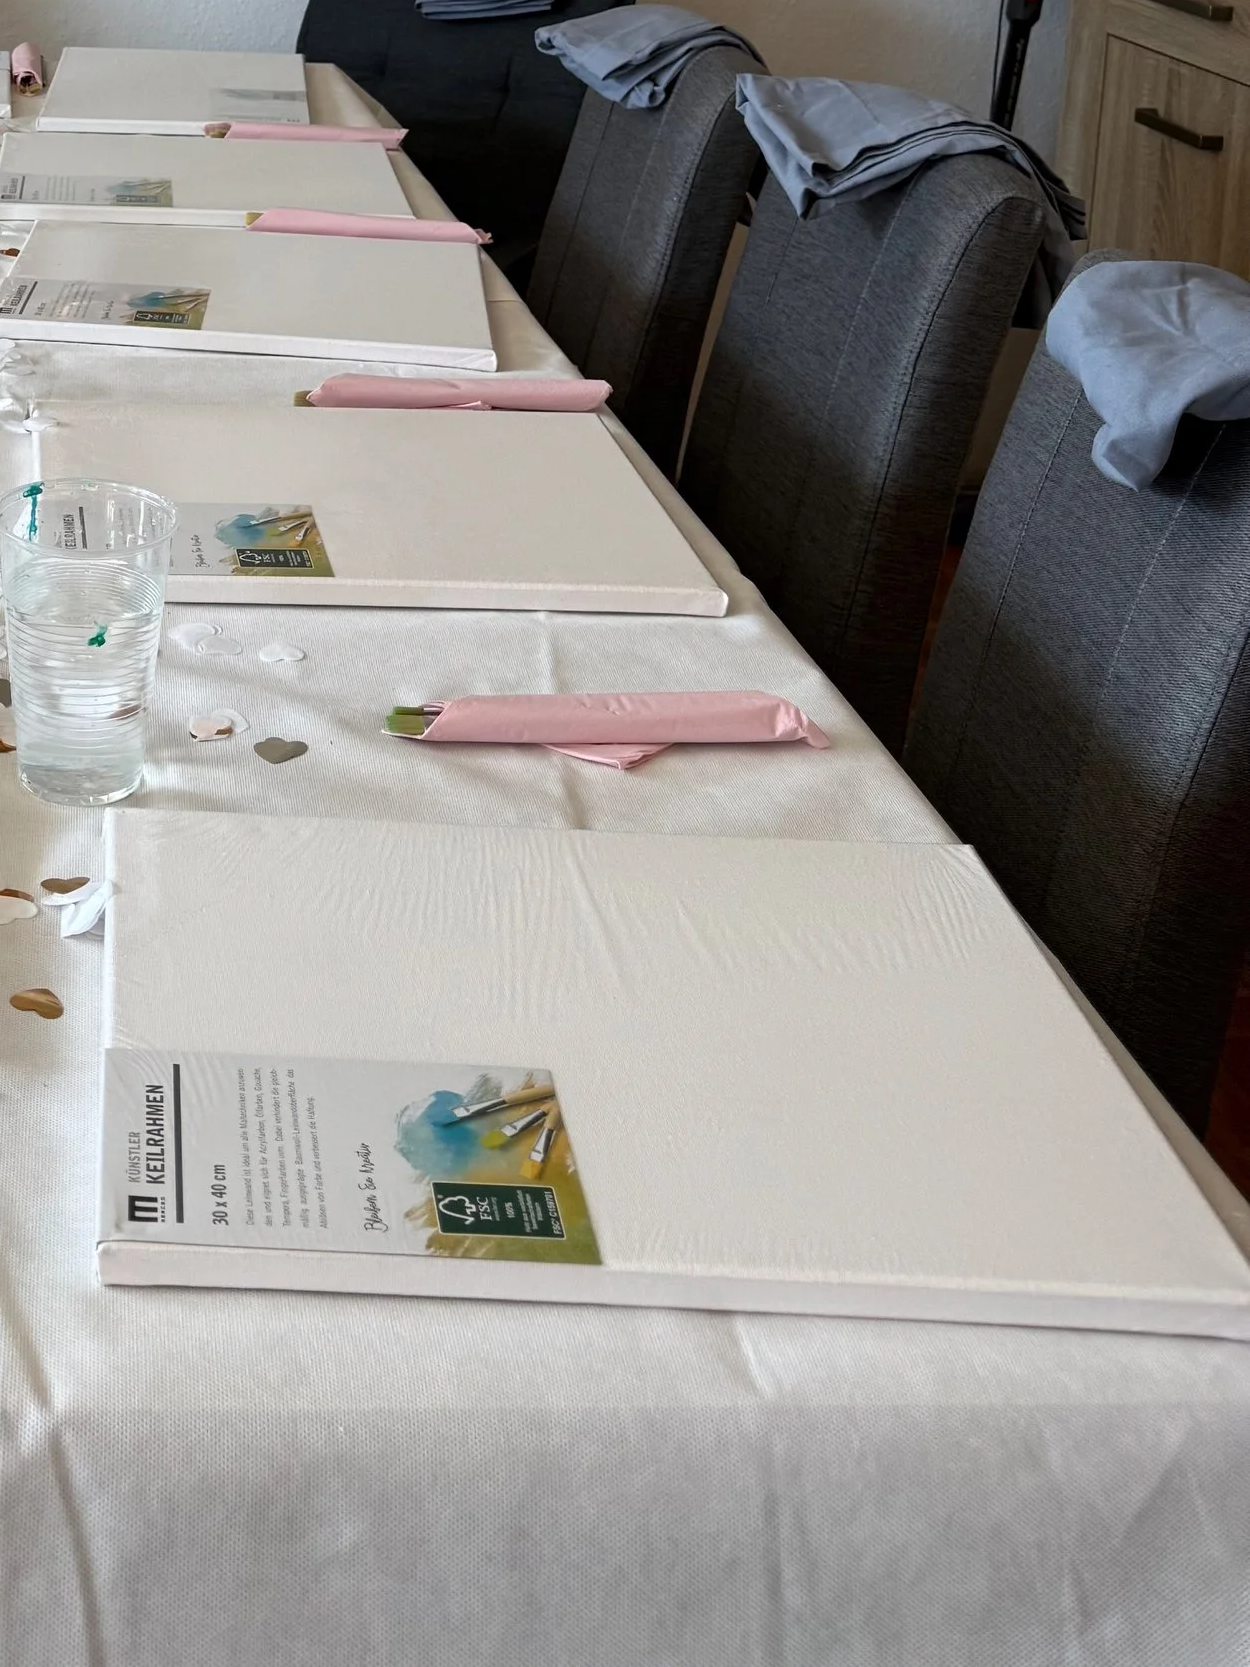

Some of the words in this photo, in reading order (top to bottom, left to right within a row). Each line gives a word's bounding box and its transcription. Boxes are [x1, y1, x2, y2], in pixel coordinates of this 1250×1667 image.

[146, 1084, 165, 1184] KEILRAHMEN
[126, 1131, 140, 1183] KÜNSTLER
[213, 1165, 226, 1181] cm
[211, 1184, 226, 1198] 40
[476, 1196, 493, 1220] FSC
[212, 1211, 229, 1226] 30
